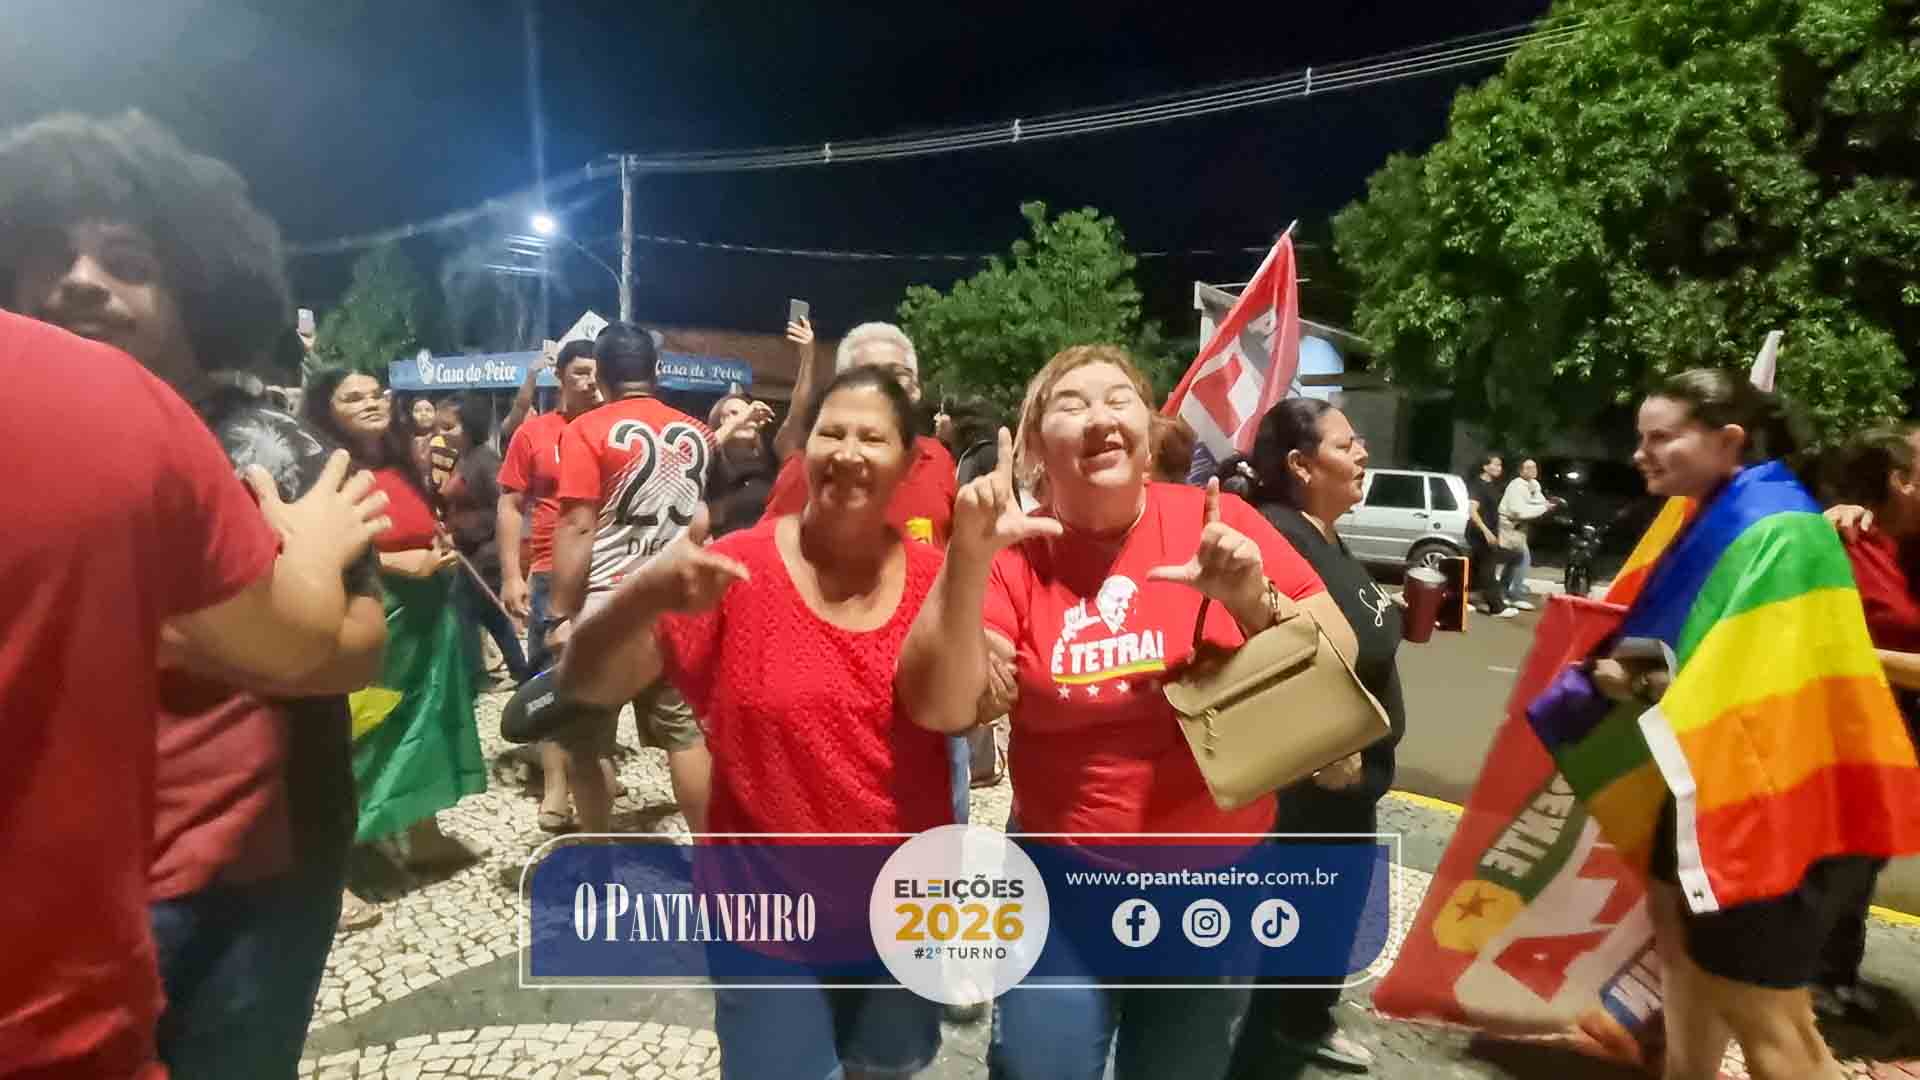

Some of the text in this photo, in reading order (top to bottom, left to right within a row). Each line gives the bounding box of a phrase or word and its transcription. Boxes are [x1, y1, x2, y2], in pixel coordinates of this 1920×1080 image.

[437, 363, 464, 384] Casa
[655, 359, 688, 377] Casa
[608, 420, 708, 527] 23
